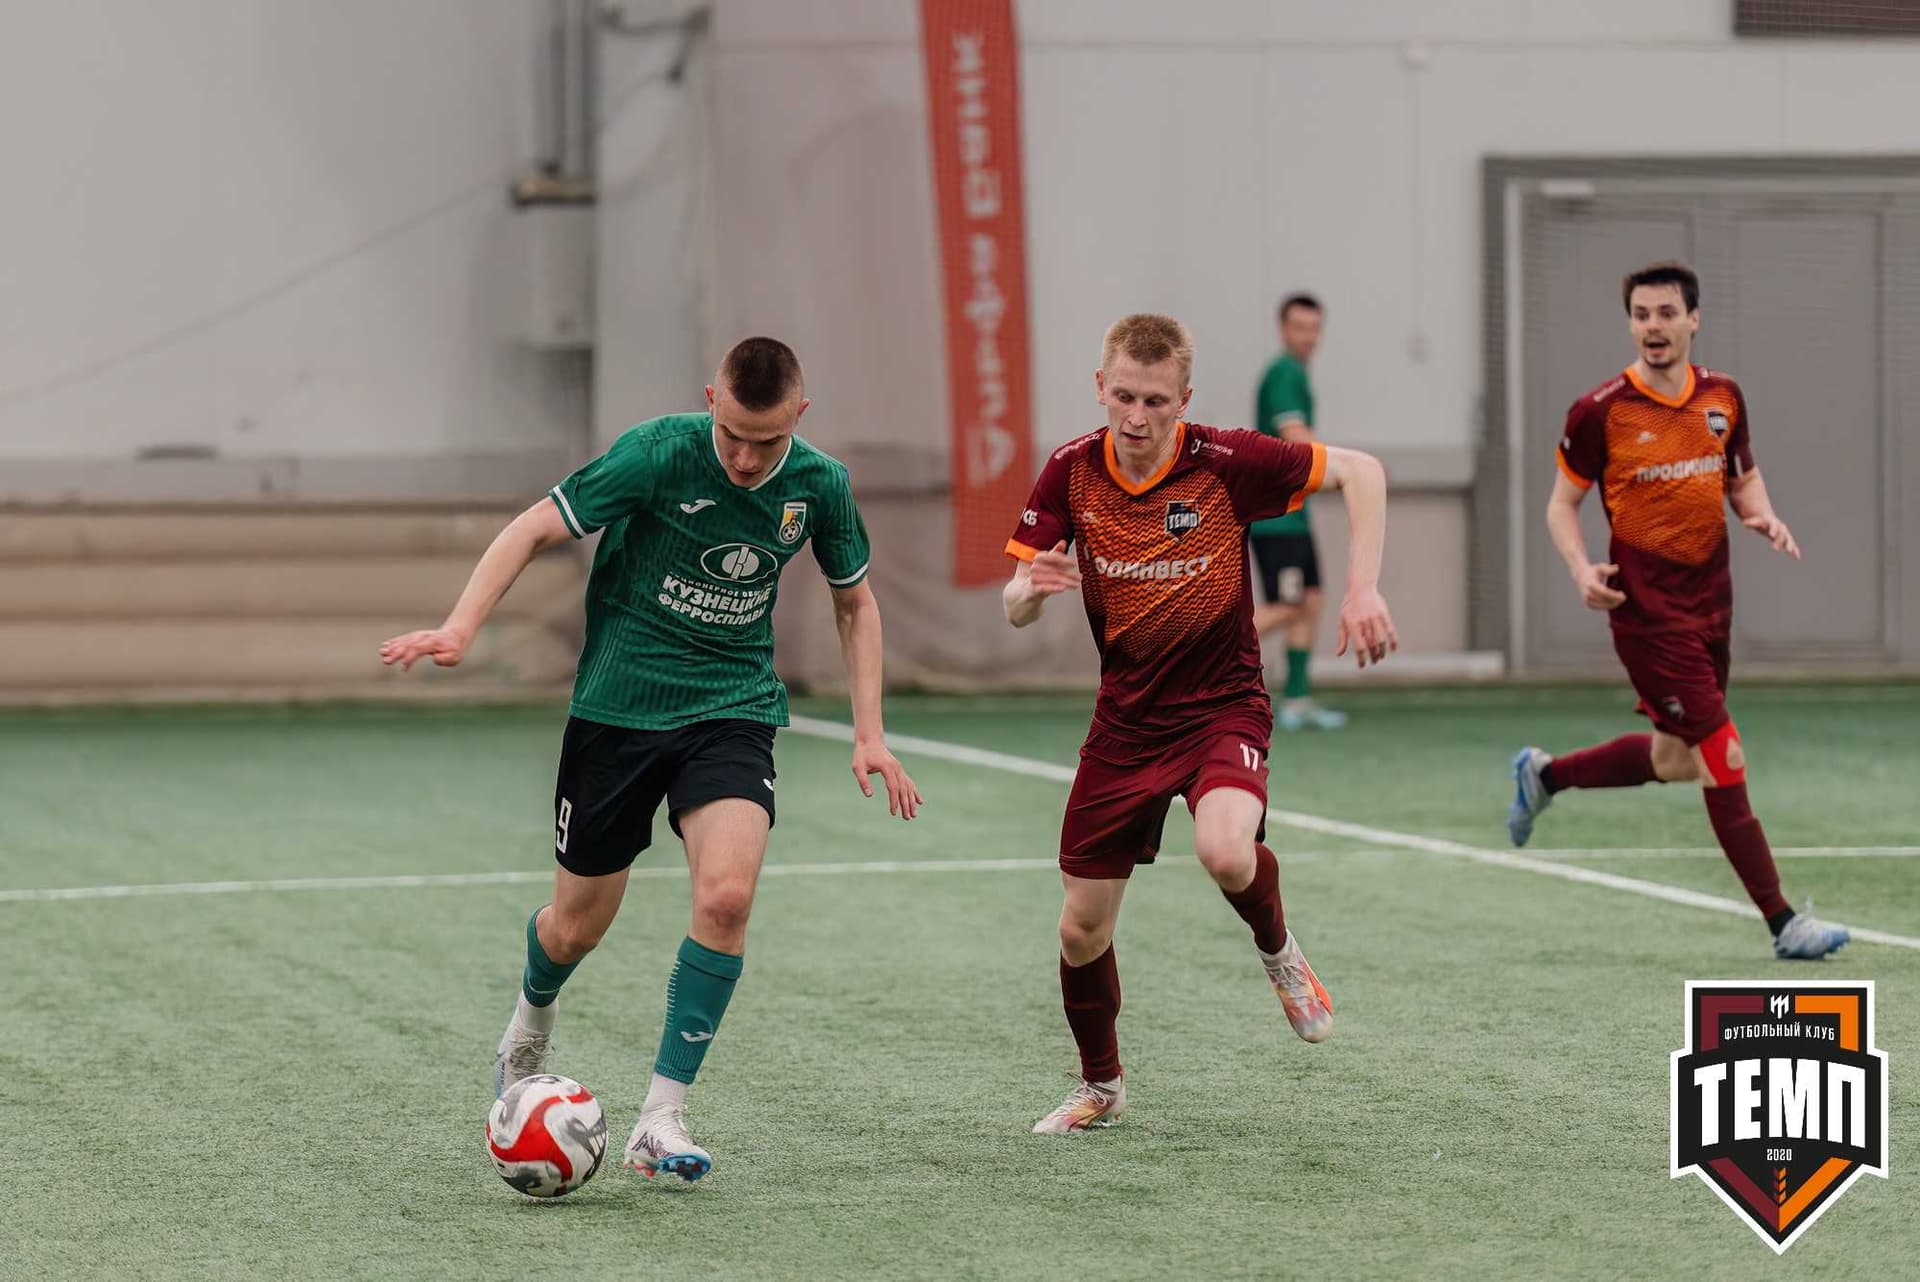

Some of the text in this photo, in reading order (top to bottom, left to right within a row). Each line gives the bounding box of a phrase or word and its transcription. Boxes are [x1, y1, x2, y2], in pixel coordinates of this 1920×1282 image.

[658, 592, 767, 626] ФЕРРОСПЛАВЫ
[662, 574, 773, 615] КУЗНЕЦКИЕ
[1239, 742, 1259, 772] 17
[556, 797, 573, 854] 9
